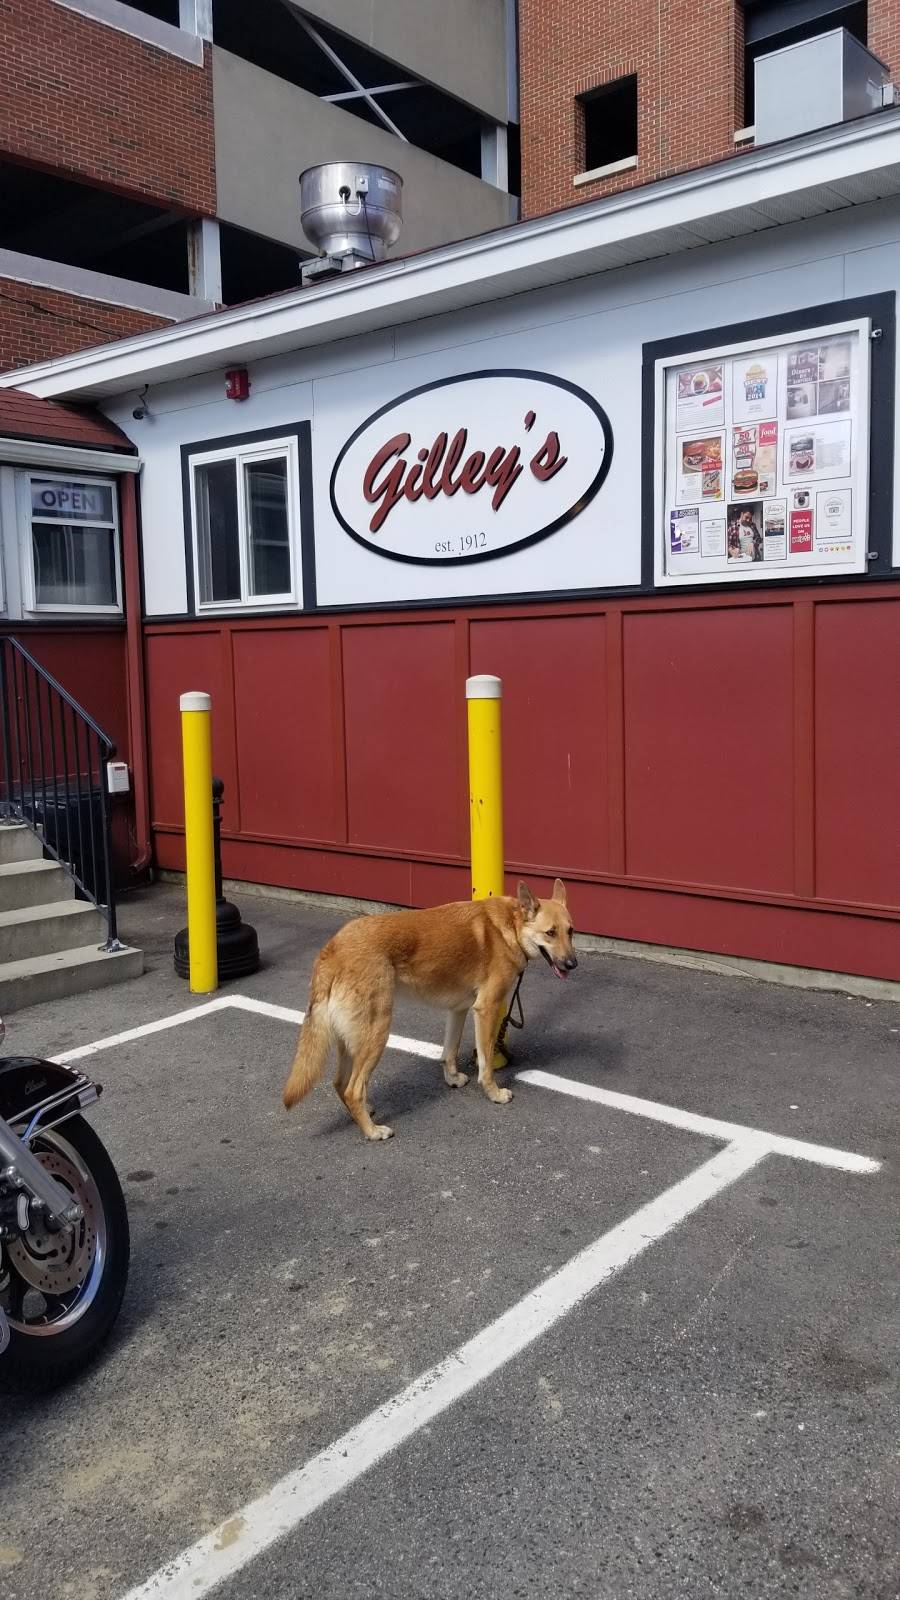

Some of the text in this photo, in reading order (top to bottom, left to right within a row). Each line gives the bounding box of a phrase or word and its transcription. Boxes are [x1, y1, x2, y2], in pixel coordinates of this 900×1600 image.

[760, 427, 776, 439] food
[363, 410, 568, 533] Gilley's
[41, 490, 97, 511] OPEN
[434, 533, 487, 553] est. 1912
